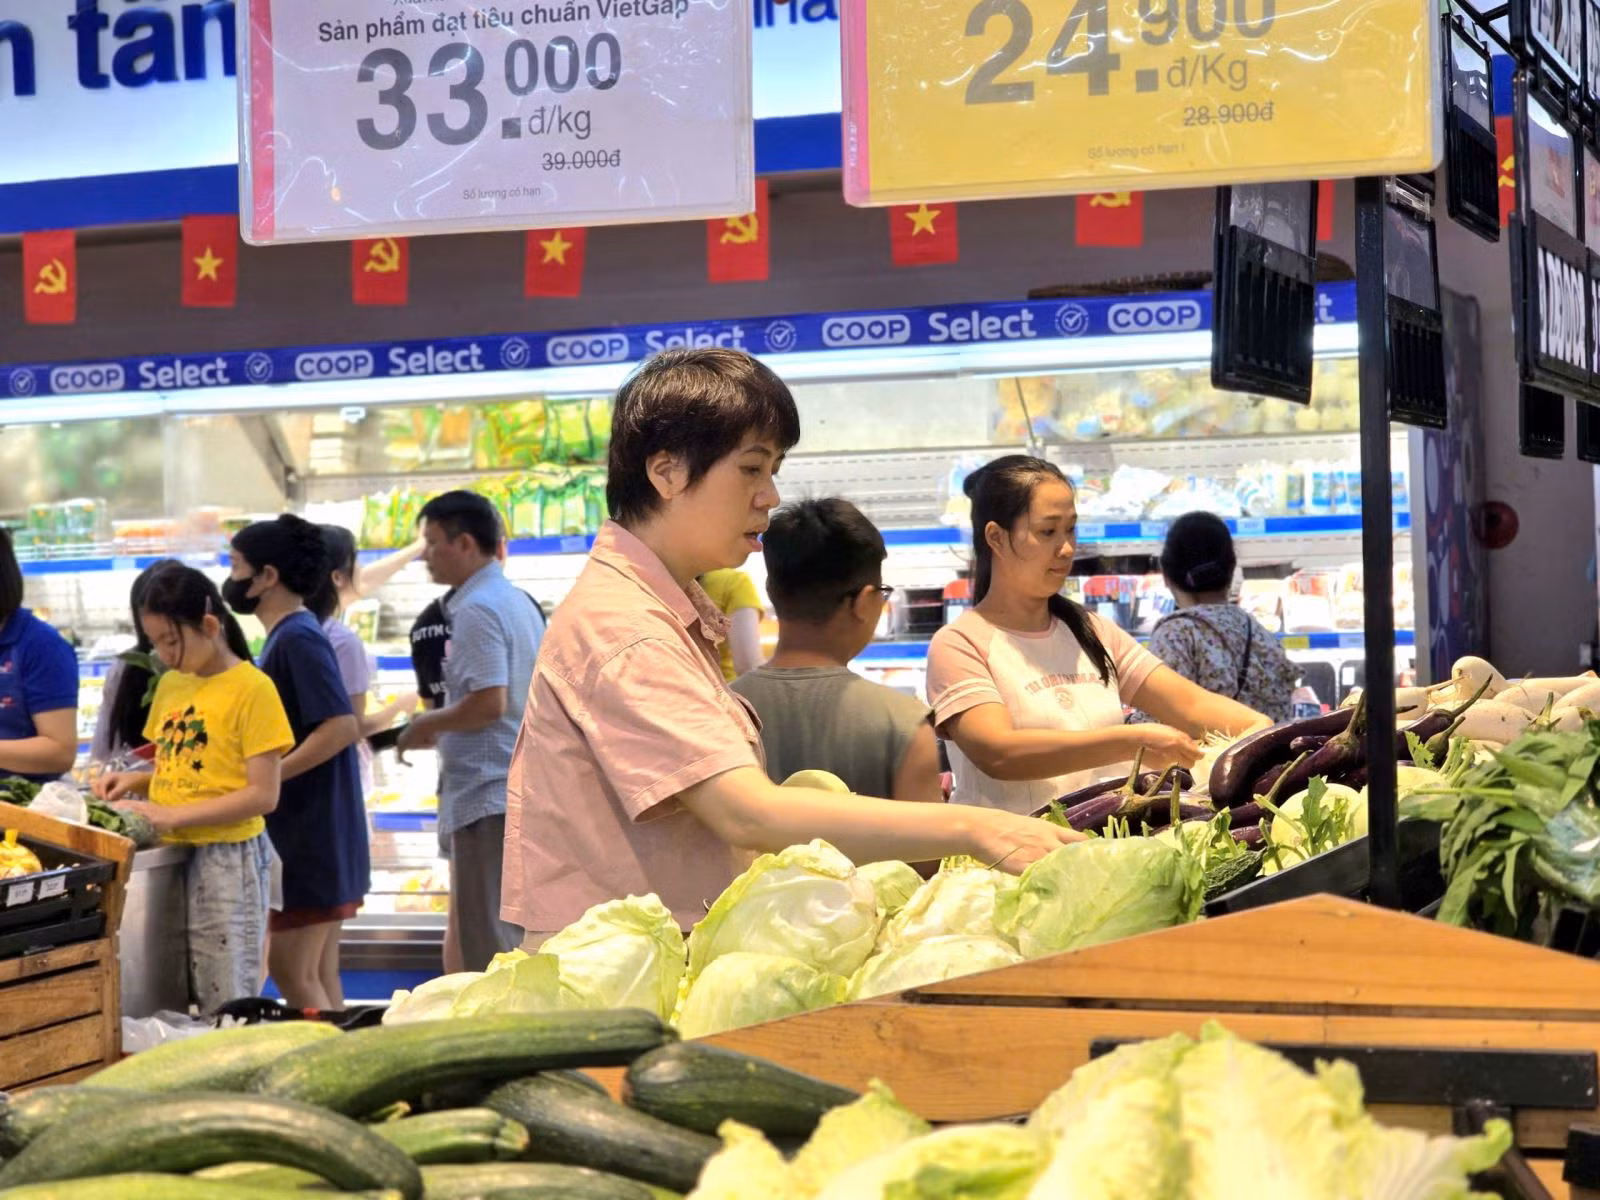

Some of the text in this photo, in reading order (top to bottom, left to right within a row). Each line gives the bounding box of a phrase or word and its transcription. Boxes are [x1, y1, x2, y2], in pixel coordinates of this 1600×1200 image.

[318, 20, 358, 43] Sản
[366, 11, 425, 43] phẩm
[432, 11, 467, 37] đạt
[473, 6, 513, 30] tiêu
[520, 0, 590, 26] chuẩn
[1166, 53, 1248, 92] đ/Kg
[528, 104, 592, 140] đ/kg
[1183, 101, 1275, 127] 28.900đ
[541, 149, 621, 171] 39.000đ
[826, 308, 1036, 343] COOP Select
[1112, 305, 1197, 328] COOP
[300, 343, 485, 377] COOP Select
[551, 325, 748, 361] COOP Select
[54, 357, 230, 391] COOP Select
